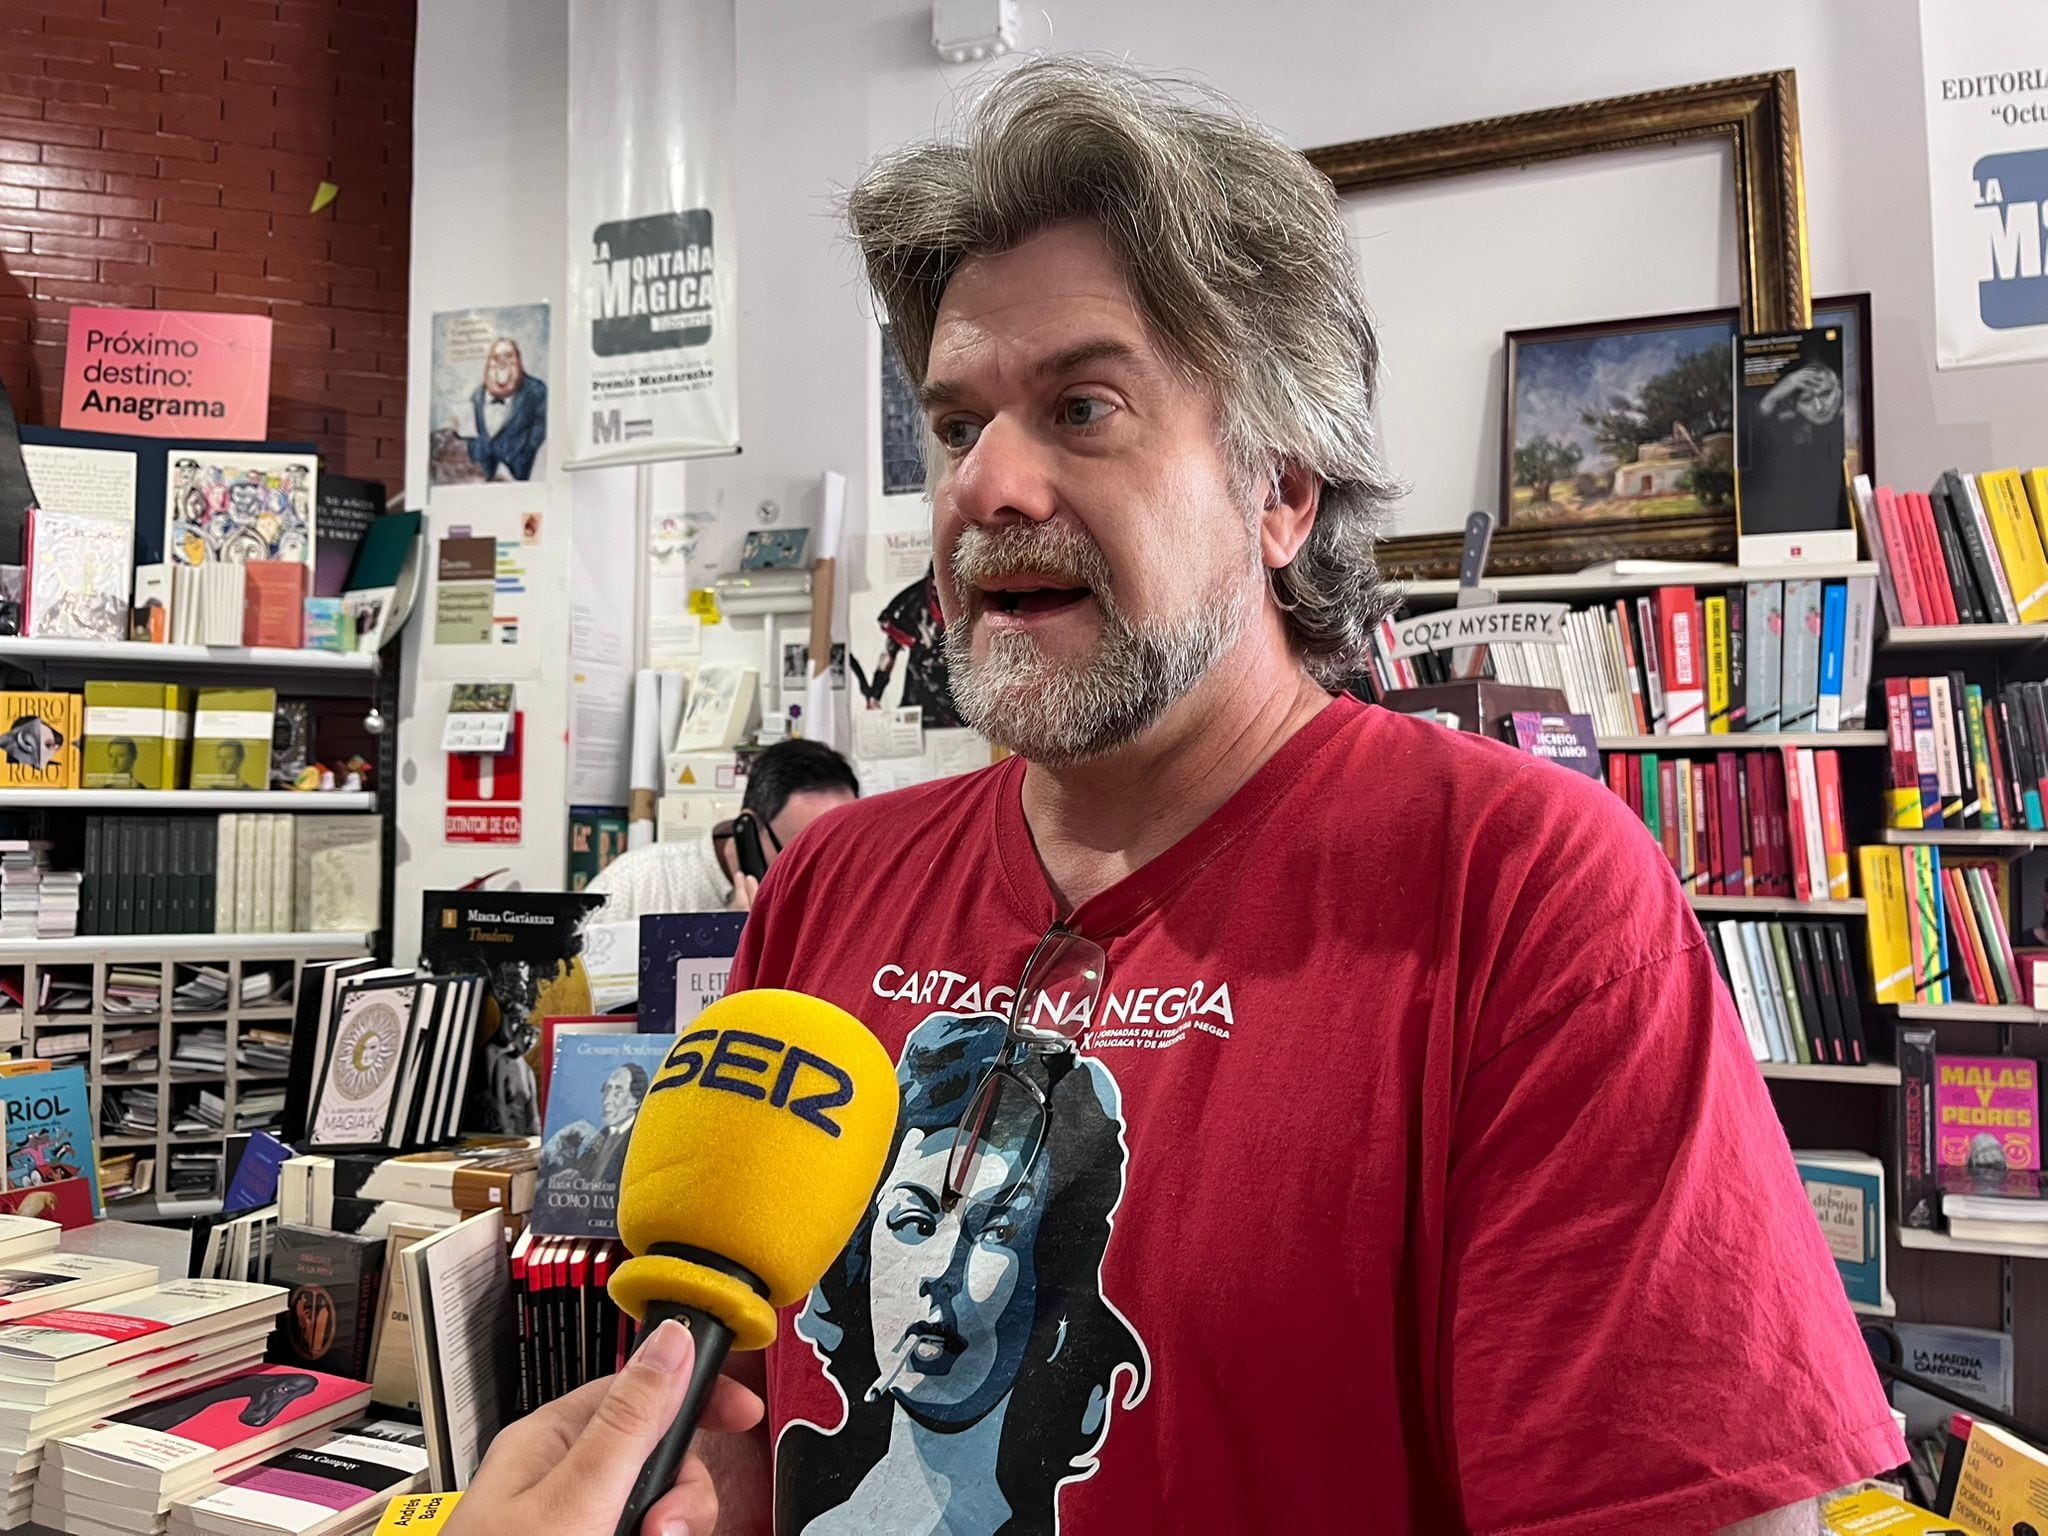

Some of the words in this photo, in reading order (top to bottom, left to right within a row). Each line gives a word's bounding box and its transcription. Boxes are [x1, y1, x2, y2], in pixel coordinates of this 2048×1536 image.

[86, 329, 199, 358] Próximo
[83, 358, 192, 387] destino:
[80, 389, 226, 422] Anagrama
[1402, 620, 1452, 648] COZY
[1459, 613, 1551, 636] MYSTERY
[7, 696, 64, 721] LIBRO
[9, 763, 60, 784] ROJO
[490, 815, 501, 834] DE
[692, 973, 703, 991] EL
[872, 963, 1092, 1028] CARTAGENA
[1100, 980, 1234, 1027] NEGRA
[1096, 1028, 1140, 1039] JORNADAS
[1141, 1028, 1153, 1037] DE
[1193, 1020, 1231, 1040] NEGRA
[1136, 1038, 1143, 1048] Y
[1144, 1039, 1157, 1049] DE
[650, 1029, 854, 1138] SER
[1941, 1065, 2033, 1090] MALAS
[1976, 1085, 1996, 1108] Y
[6, 1095, 71, 1125] RiOL
[548, 1192, 590, 1209] COMO
[1812, 1194, 1858, 1214] dibujo
[1913, 1349, 1930, 1363] LA
[393, 1498, 421, 1526] Andrés
[417, 1496, 443, 1520] Barba
